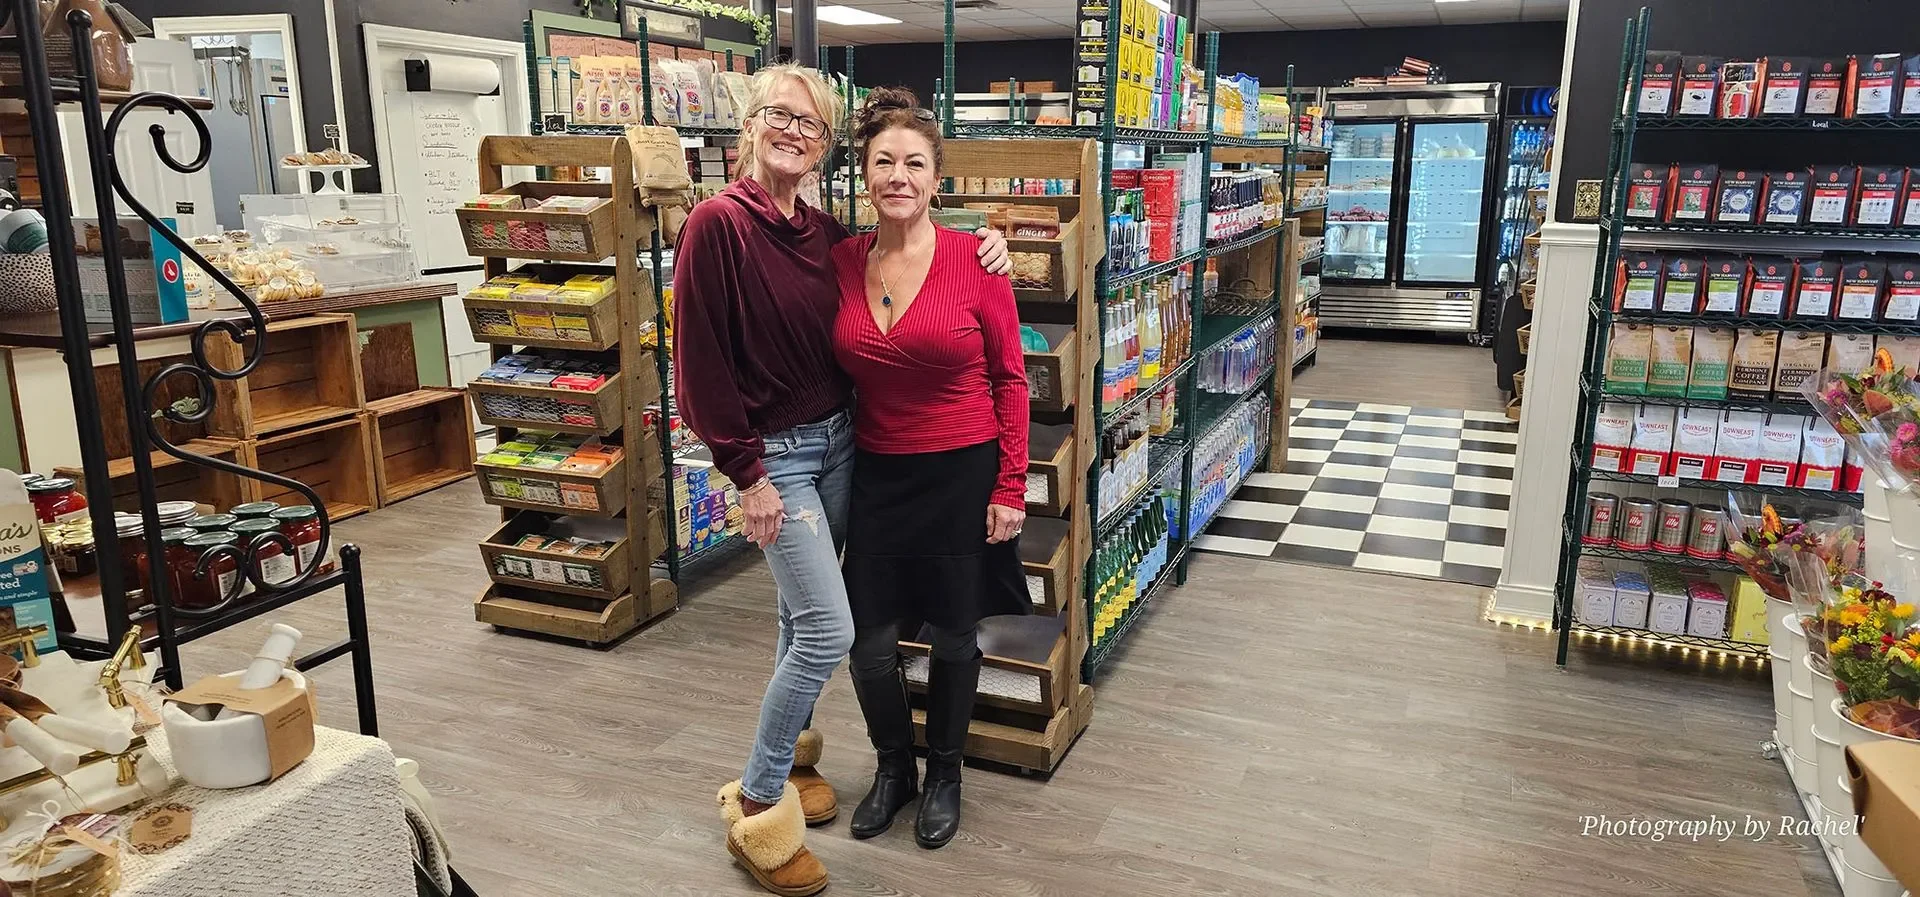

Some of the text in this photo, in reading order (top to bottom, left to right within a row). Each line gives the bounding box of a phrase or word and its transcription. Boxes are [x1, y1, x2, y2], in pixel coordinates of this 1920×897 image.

[545, 117, 563, 130] Tea
[1812, 120, 1829, 128] Local
[1016, 229, 1047, 238] GINGER
[1599, 418, 1629, 426] DOWNEAST
[1640, 422, 1669, 431] DOWNEAST
[1682, 424, 1712, 433] DOWNEAST
[1723, 427, 1755, 436] DOWNEAST
[1763, 431, 1796, 440] DOWNEAST
[1597, 510, 1608, 520] illy
[1629, 515, 1641, 525] illy
[1666, 517, 1678, 527] illy
[1703, 523, 1715, 533] illy
